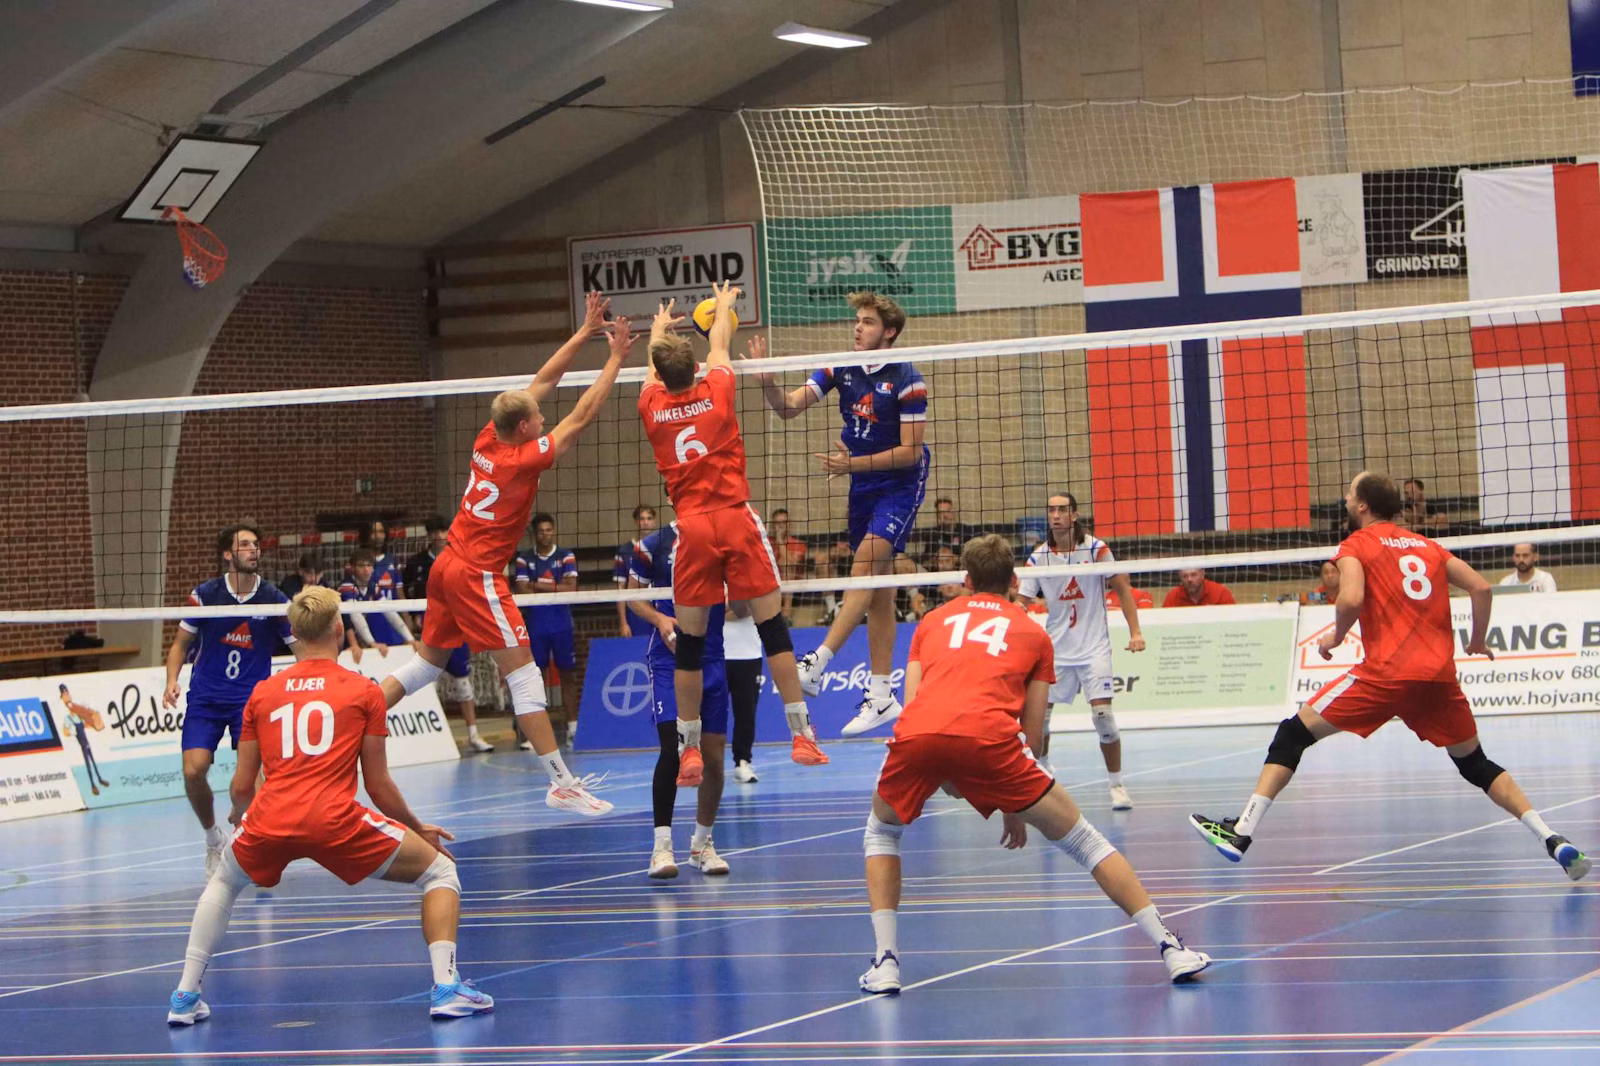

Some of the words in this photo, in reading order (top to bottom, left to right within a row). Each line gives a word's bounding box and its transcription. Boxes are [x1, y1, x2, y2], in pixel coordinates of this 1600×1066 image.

[581, 244, 683, 262] ENTREPRENØR
[1007, 230, 1080, 260] BYG
[806, 249, 875, 285] jysk
[1375, 254, 1459, 273] GRINDSTED
[653, 398, 714, 423] MIKELSONS
[675, 425, 709, 464] 6
[1398, 554, 1433, 600] 8
[967, 600, 1003, 611] DAHL
[225, 632, 252, 643] MAIF
[943, 611, 1011, 657] 14
[225, 650, 241, 680] 8
[285, 676, 326, 692] KJÆR
[657, 700, 664, 715] 3
[269, 700, 335, 759] 10
[387, 709, 443, 739] mune
